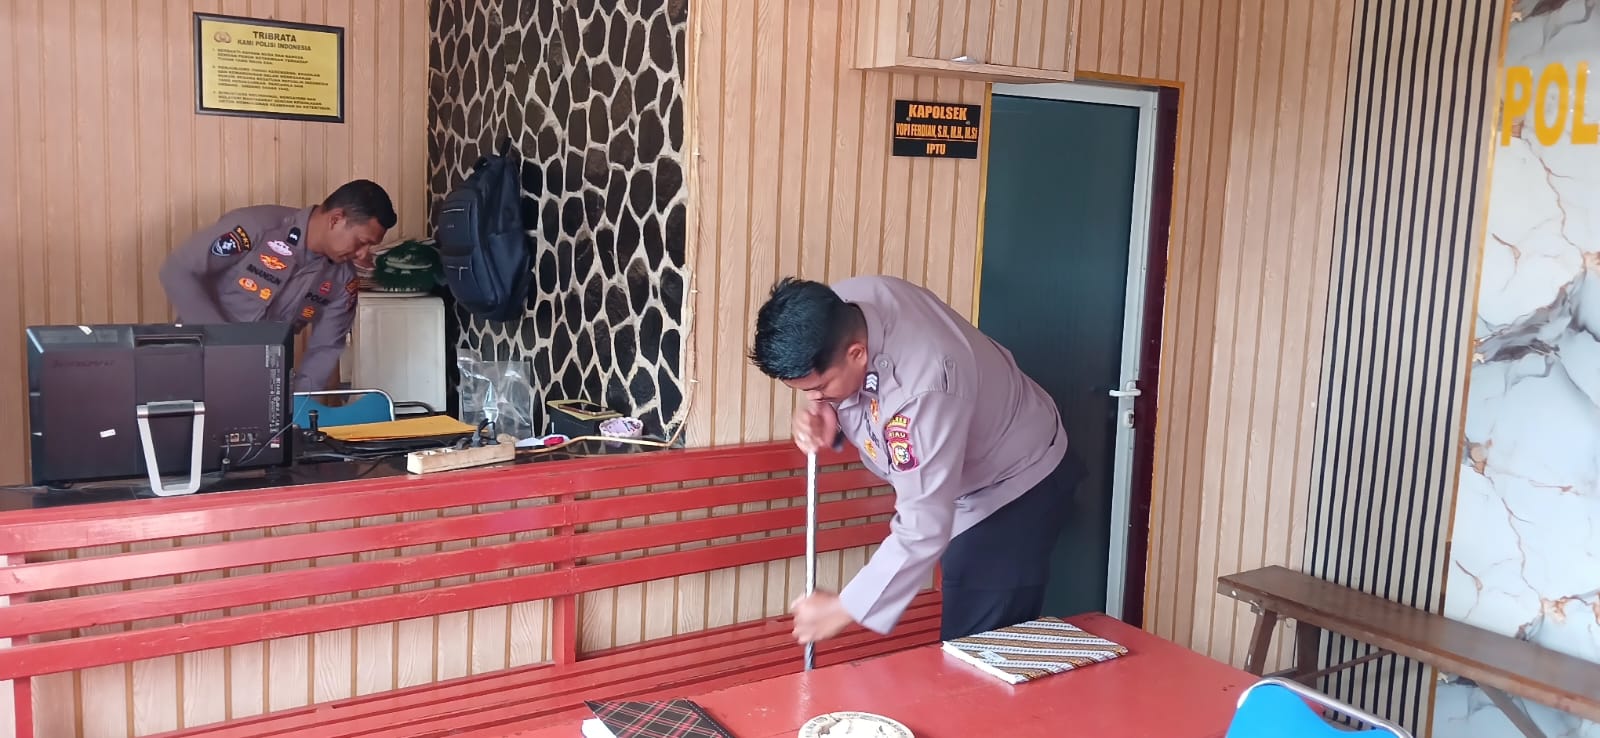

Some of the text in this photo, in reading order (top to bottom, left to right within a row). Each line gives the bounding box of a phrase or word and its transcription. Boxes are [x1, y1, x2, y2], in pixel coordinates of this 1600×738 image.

[252, 31, 297, 42] TRIBRATA
[255, 41, 276, 49] POLISI
[277, 42, 312, 51] INDONESIA
[909, 104, 967, 120] KAPOLSEK
[896, 122, 910, 136] YOPI
[926, 143, 946, 155] IPTU
